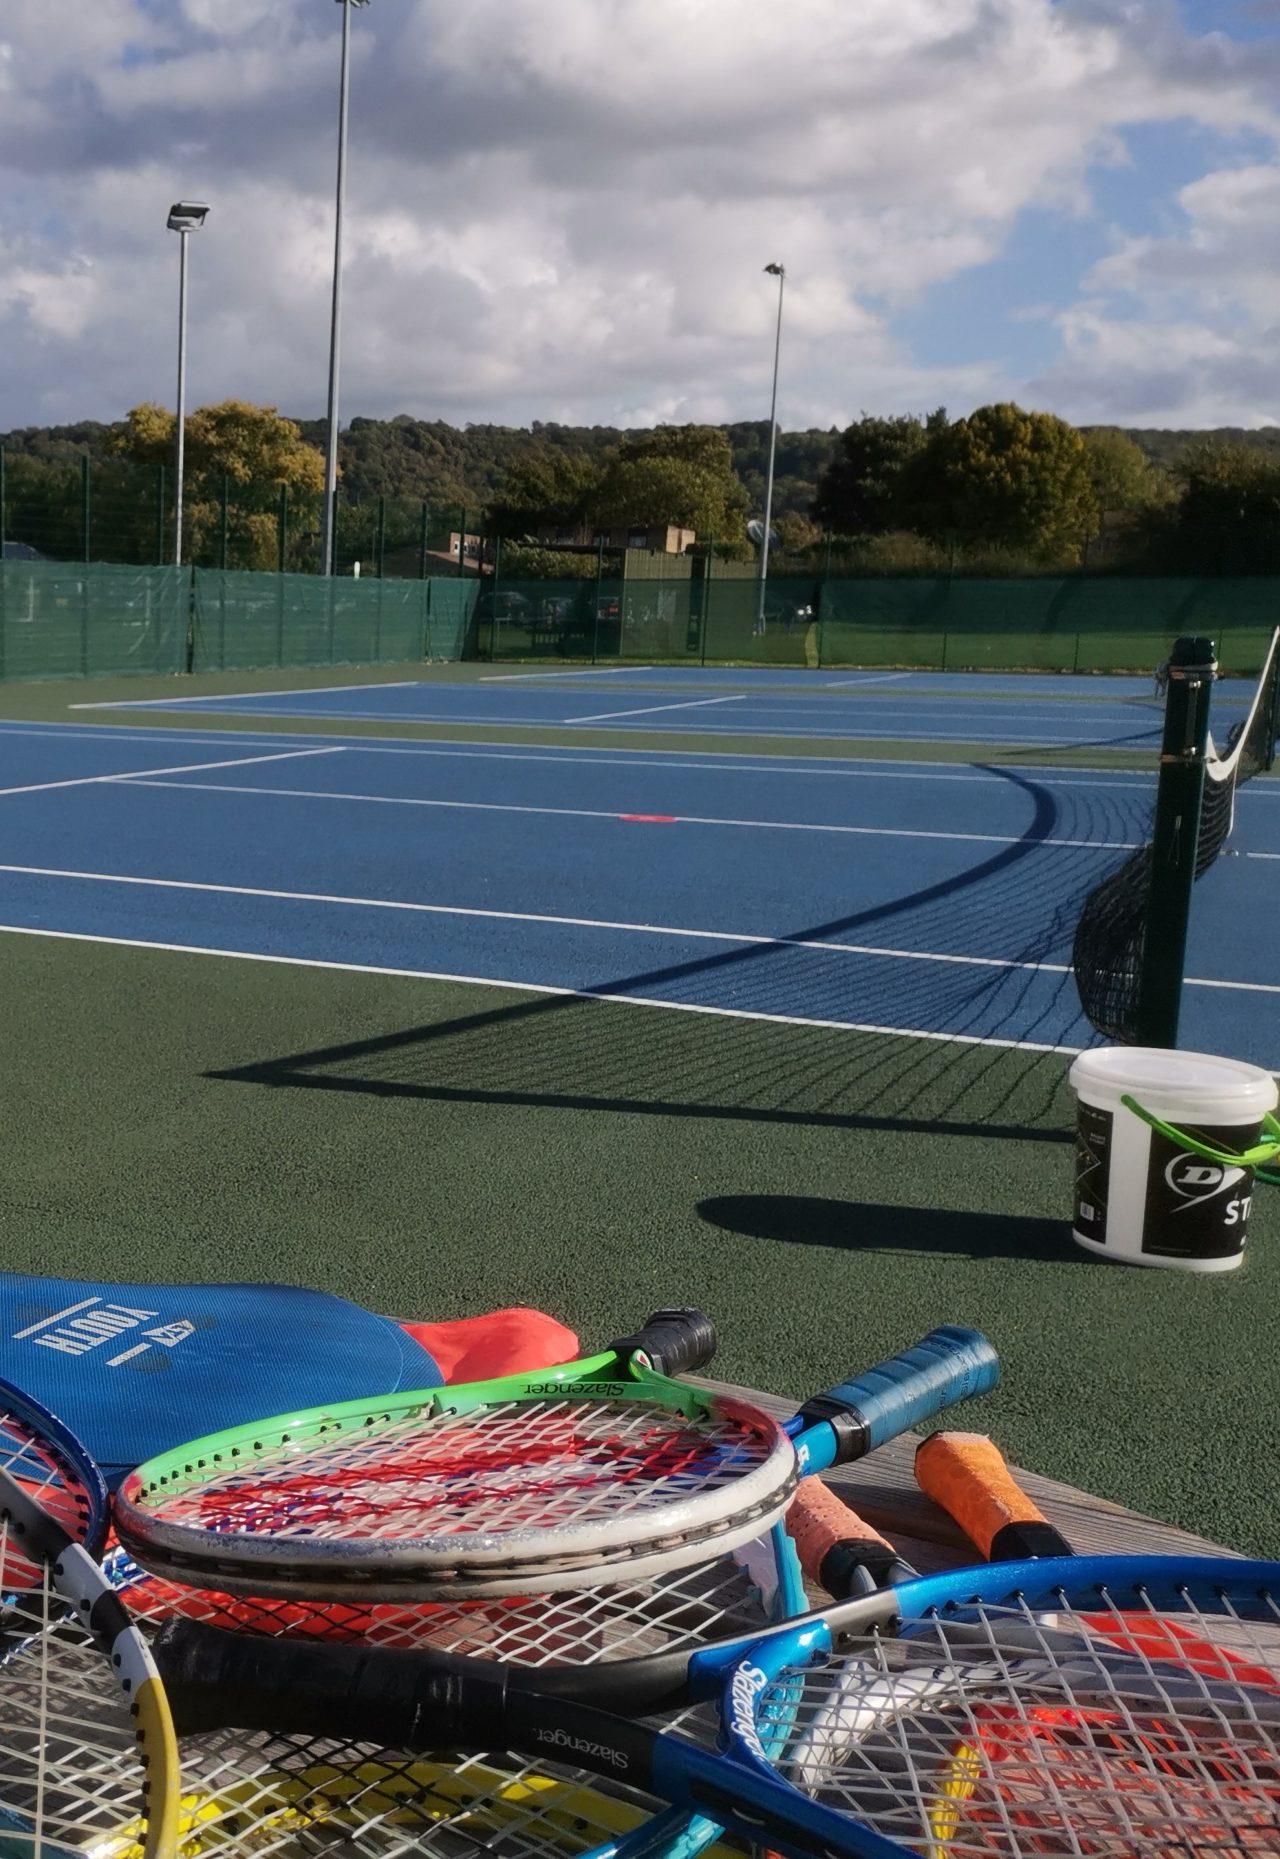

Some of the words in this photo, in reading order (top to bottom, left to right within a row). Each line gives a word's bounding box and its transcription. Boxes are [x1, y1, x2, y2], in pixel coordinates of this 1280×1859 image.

[33, 1304, 159, 1356] YOUTH
[523, 1382, 627, 1397] Slazenger
[536, 1728, 629, 1769] Slazenger
